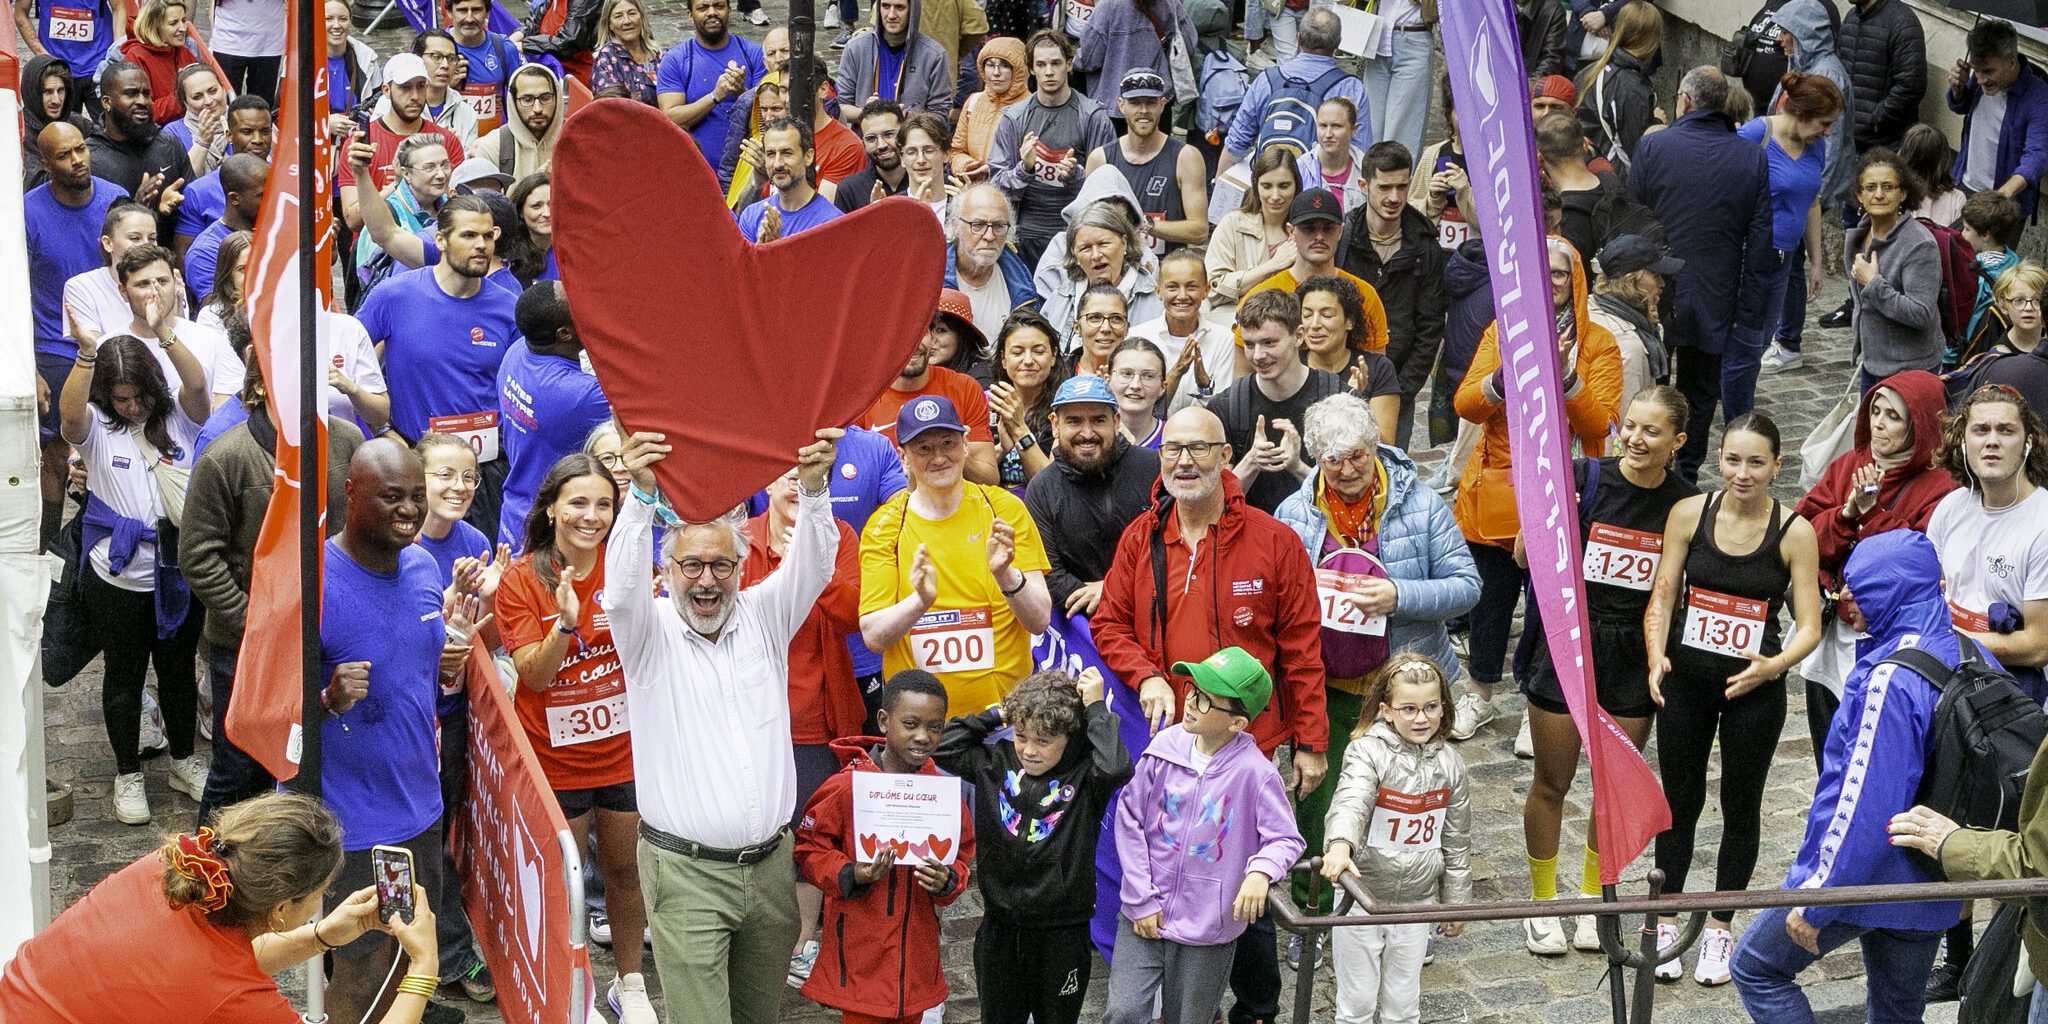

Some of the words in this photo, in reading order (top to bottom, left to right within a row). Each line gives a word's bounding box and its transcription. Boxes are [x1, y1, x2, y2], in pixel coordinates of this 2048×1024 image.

[1067, 2, 1093, 20] 212
[56, 21, 88, 37] 245
[1437, 225, 1468, 243] 91
[1600, 552, 1653, 582] 129
[1698, 616, 1751, 649] 130
[923, 635, 983, 666] 200
[580, 660, 621, 683] cœu
[570, 705, 611, 734] 30
[869, 790, 901, 800] DIPLÔME
[903, 792, 914, 801] DU
[1387, 815, 1435, 844] 128
